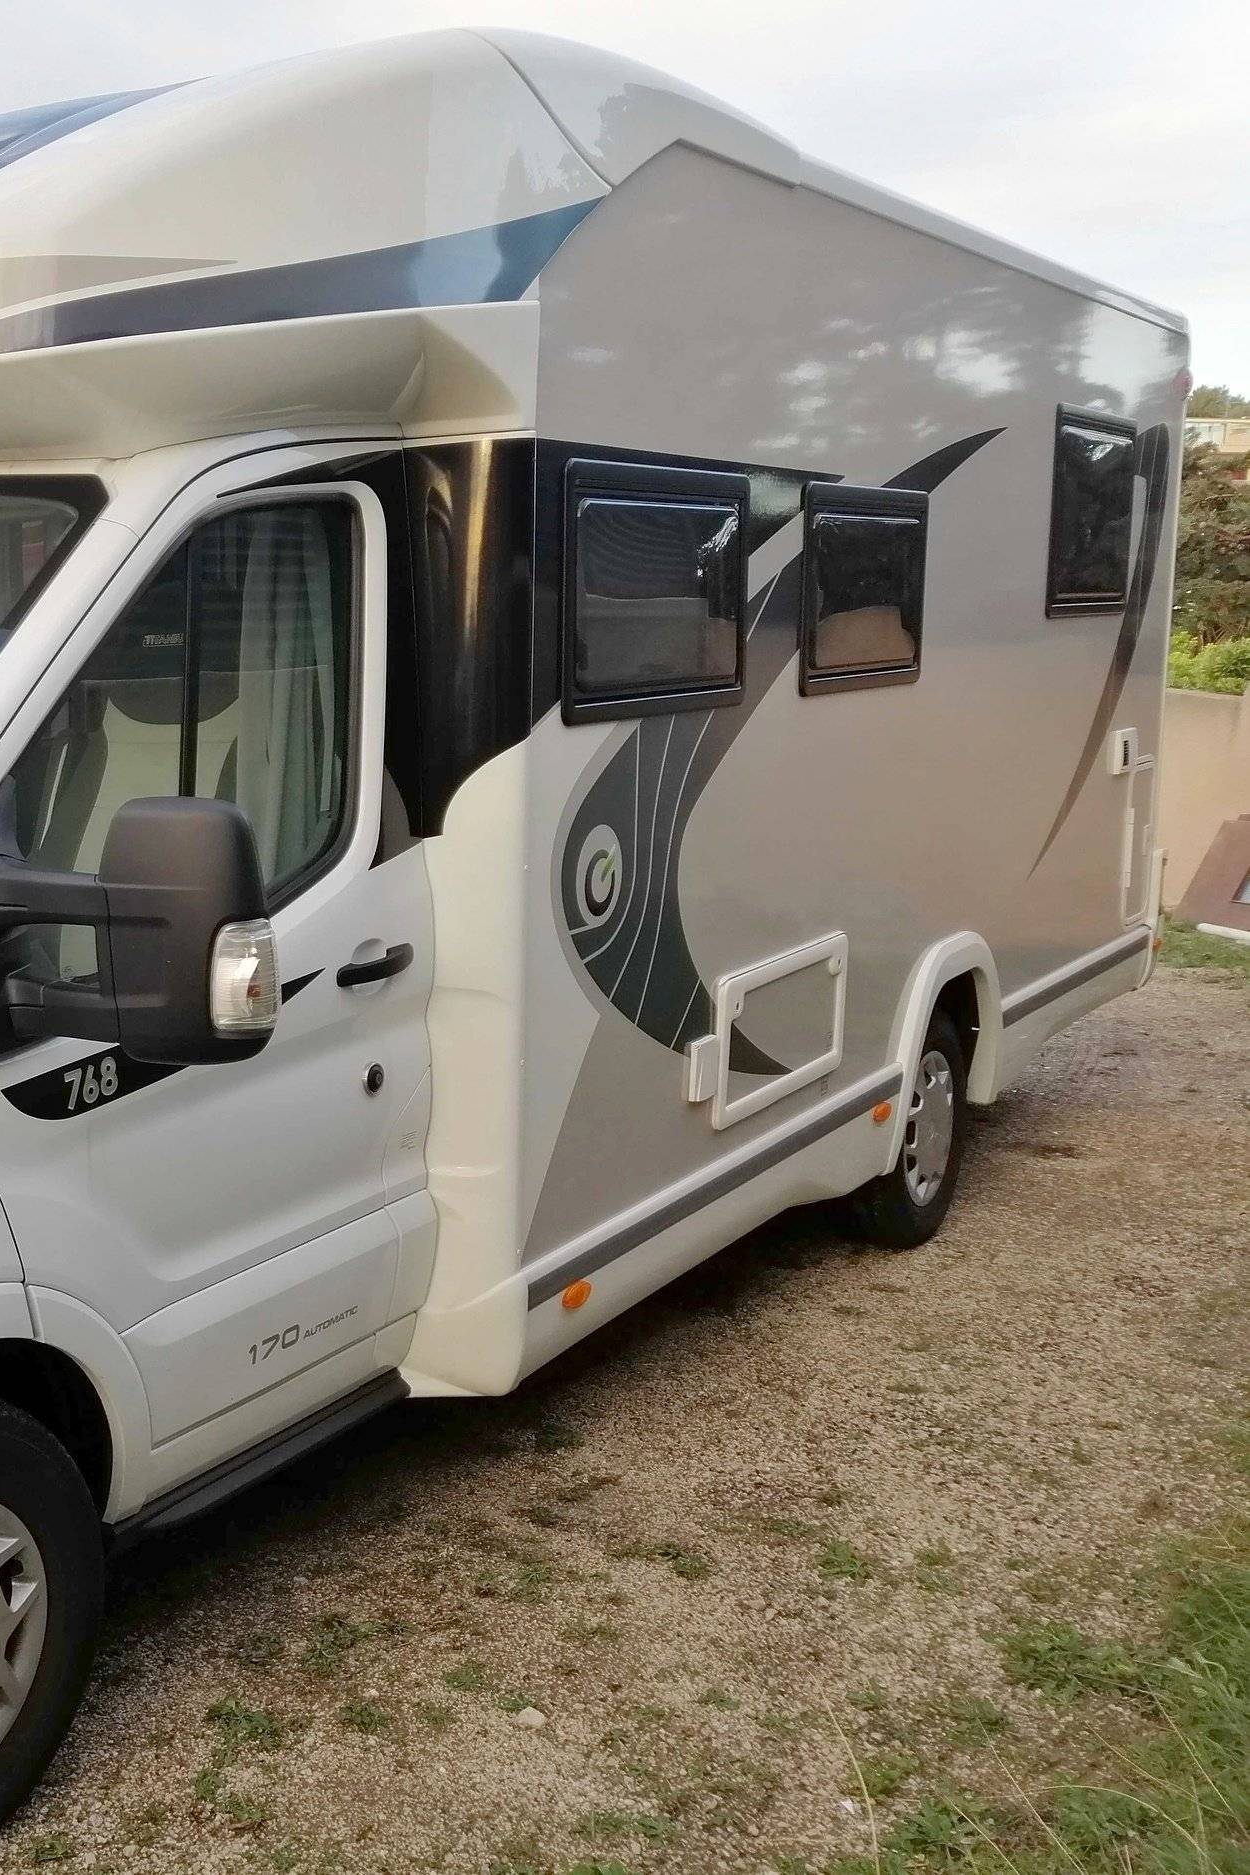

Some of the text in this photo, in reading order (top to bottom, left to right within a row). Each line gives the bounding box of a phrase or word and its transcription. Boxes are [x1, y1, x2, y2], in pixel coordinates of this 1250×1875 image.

[64, 1056, 119, 1110] 768
[248, 1305, 359, 1365] 170 AUTOMATIC
